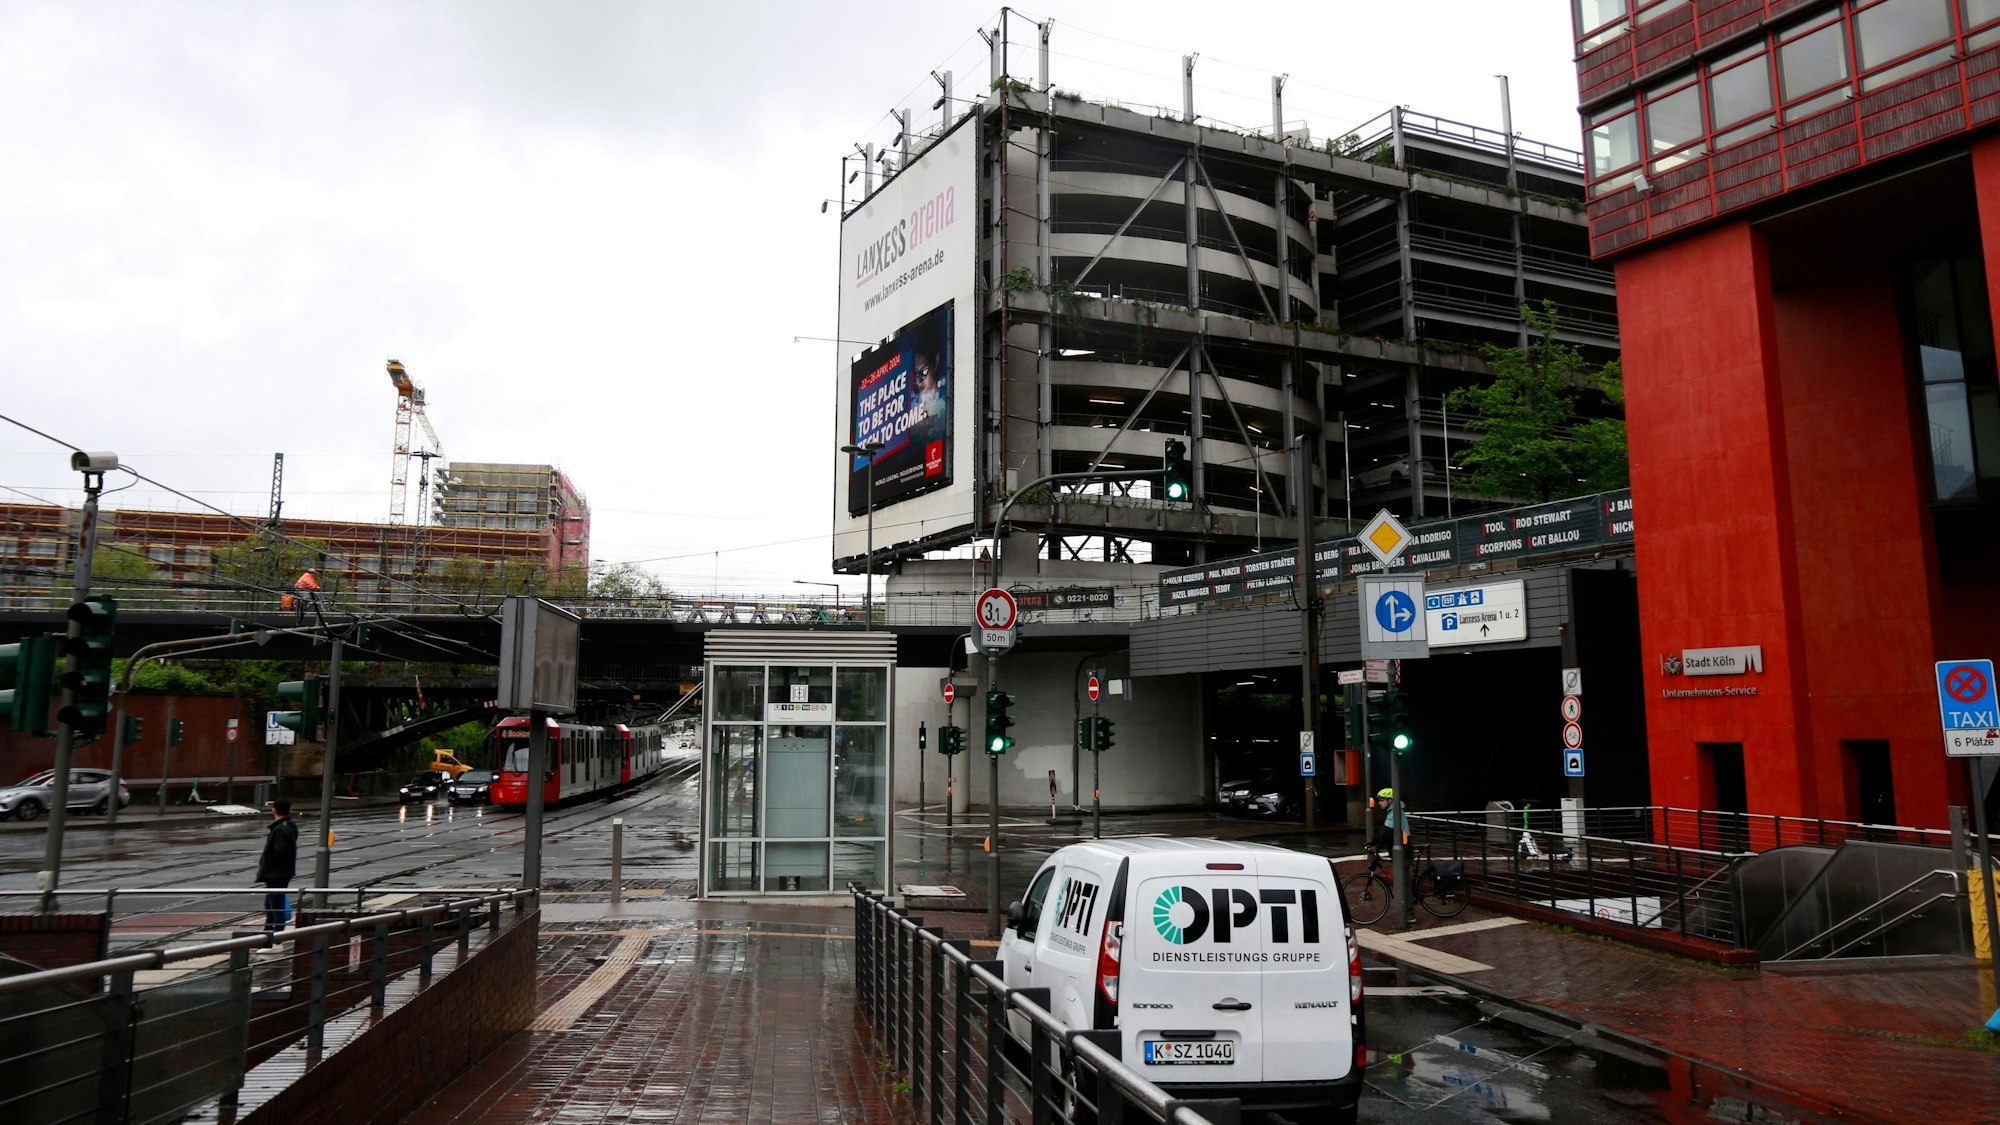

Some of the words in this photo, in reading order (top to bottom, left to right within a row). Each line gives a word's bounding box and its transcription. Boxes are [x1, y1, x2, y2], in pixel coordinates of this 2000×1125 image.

[857, 219, 906, 280] LANXESS
[910, 185, 955, 250] arena
[864, 248, 944, 312] www.lanxess-arena.de
[860, 397, 877, 418] THE
[878, 371, 907, 398] PLACE
[858, 419, 870, 438] TO
[871, 412, 883, 428] BE
[885, 394, 904, 419] FOR
[881, 422, 894, 445] TO
[895, 402, 928, 436] COME.
[1485, 521, 1506, 534] TOOL
[1516, 517, 1532, 529] ROD
[1533, 510, 1572, 526] STEWART
[1420, 530, 1452, 544] RODRIGO
[1479, 539, 1522, 555] SCORPIONS
[1531, 535, 1547, 547] CAT
[1548, 530, 1580, 544] BALLOU
[1323, 550, 1339, 560] BERG
[1348, 546, 1362, 557] REA
[1412, 550, 1451, 565] CAVALLUNA
[1245, 561, 1270, 573] TORSTEN
[1270, 556, 1295, 570] STRÄTER
[1350, 562, 1370, 574] JONAS
[1208, 569, 1221, 579] PAUL
[1221, 566, 1241, 578] PANZER
[1215, 583, 1231, 594] TEDDY
[1018, 595, 1042, 606] arena
[1067, 593, 1109, 603] 0221-8020
[1460, 614, 1481, 625] Lanxess
[1481, 612, 1497, 622] Arena
[1499, 611, 1503, 619] 1
[1514, 608, 1519, 619] 2
[1685, 656, 1711, 668] Stadt
[1713, 655, 1735, 667] Köln
[1662, 686, 1757, 698] Unternehmens-Service
[1948, 711, 1994, 728] TAXI
[1954, 737, 1962, 747] 6
[1965, 736, 1994, 747] Plätze
[1056, 876, 1100, 937] OPTI
[1153, 886, 1320, 945] OPTI
[1153, 952, 1268, 962] DIENSTLEISTUNGS
[1273, 952, 1320, 962] GRUPPE
[1294, 1001, 1339, 1009] RENAULT
[1154, 1044, 1164, 1059] K
[1174, 1044, 1193, 1059] SZ
[1195, 1044, 1232, 1059] 1040
